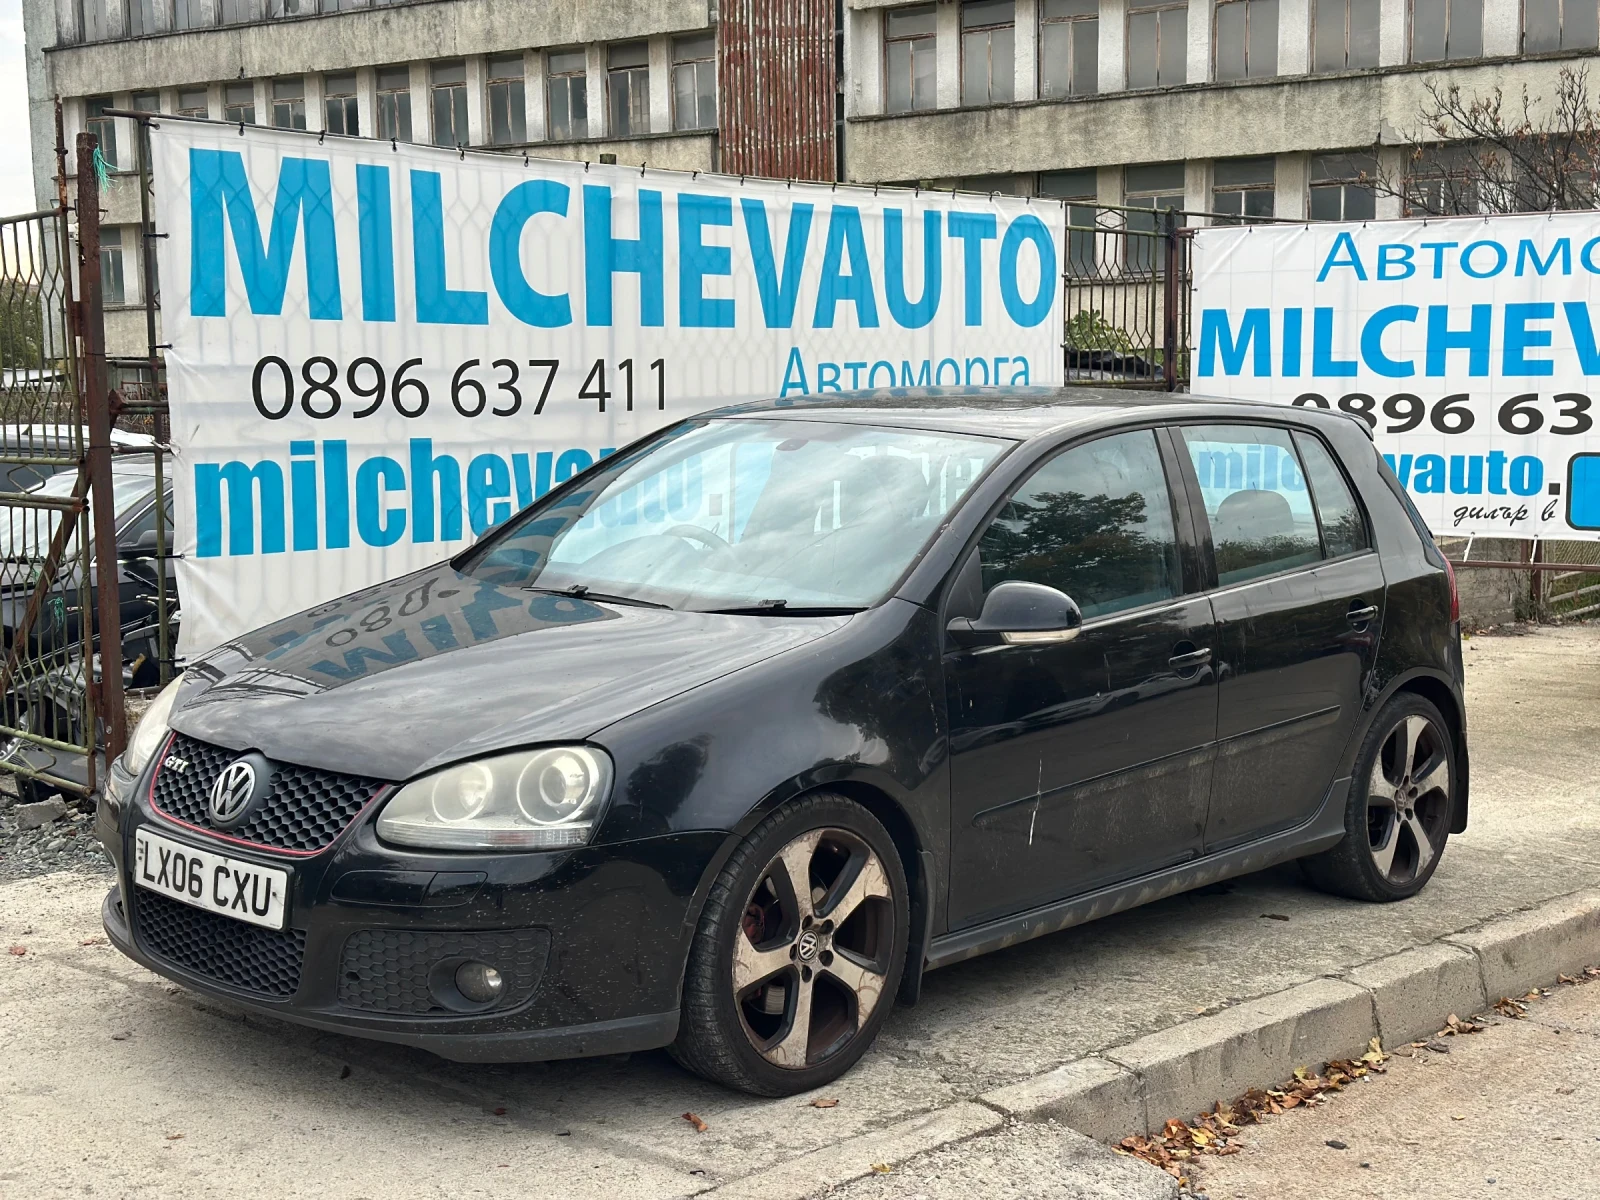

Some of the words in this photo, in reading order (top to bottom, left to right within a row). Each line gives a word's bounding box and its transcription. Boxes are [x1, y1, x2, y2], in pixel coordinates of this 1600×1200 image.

[190, 148, 1058, 330] MILCHEVAUTO
[251, 355, 430, 420] 0896
[450, 358, 560, 416] 637
[577, 358, 667, 413] 411
[165, 755, 189, 774] GTI
[142, 840, 204, 899] LX06
[213, 865, 272, 917] CXU
